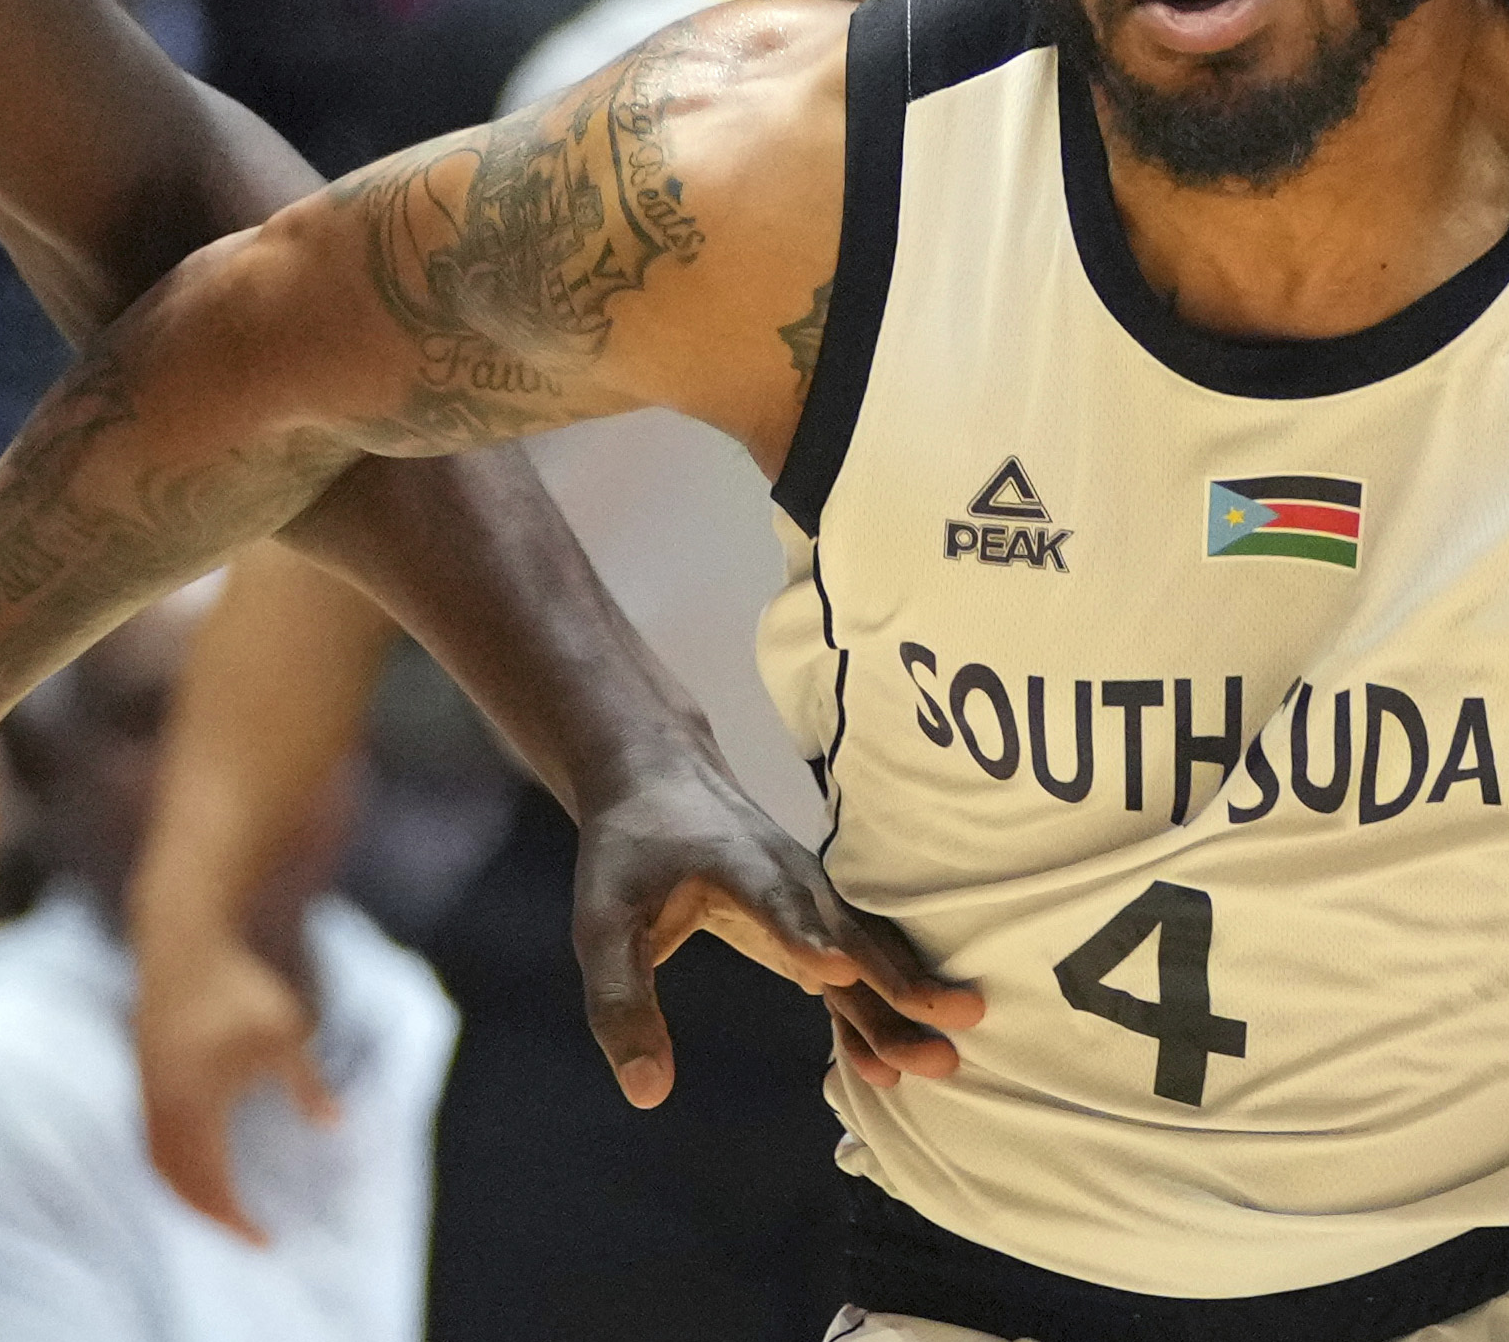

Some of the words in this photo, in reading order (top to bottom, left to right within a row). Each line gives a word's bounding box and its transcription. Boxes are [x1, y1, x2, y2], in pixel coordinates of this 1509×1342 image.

[943, 520, 1074, 573] PEAK
[900, 641, 1244, 826] SOUTH
[1053, 880, 1247, 1107] 4
